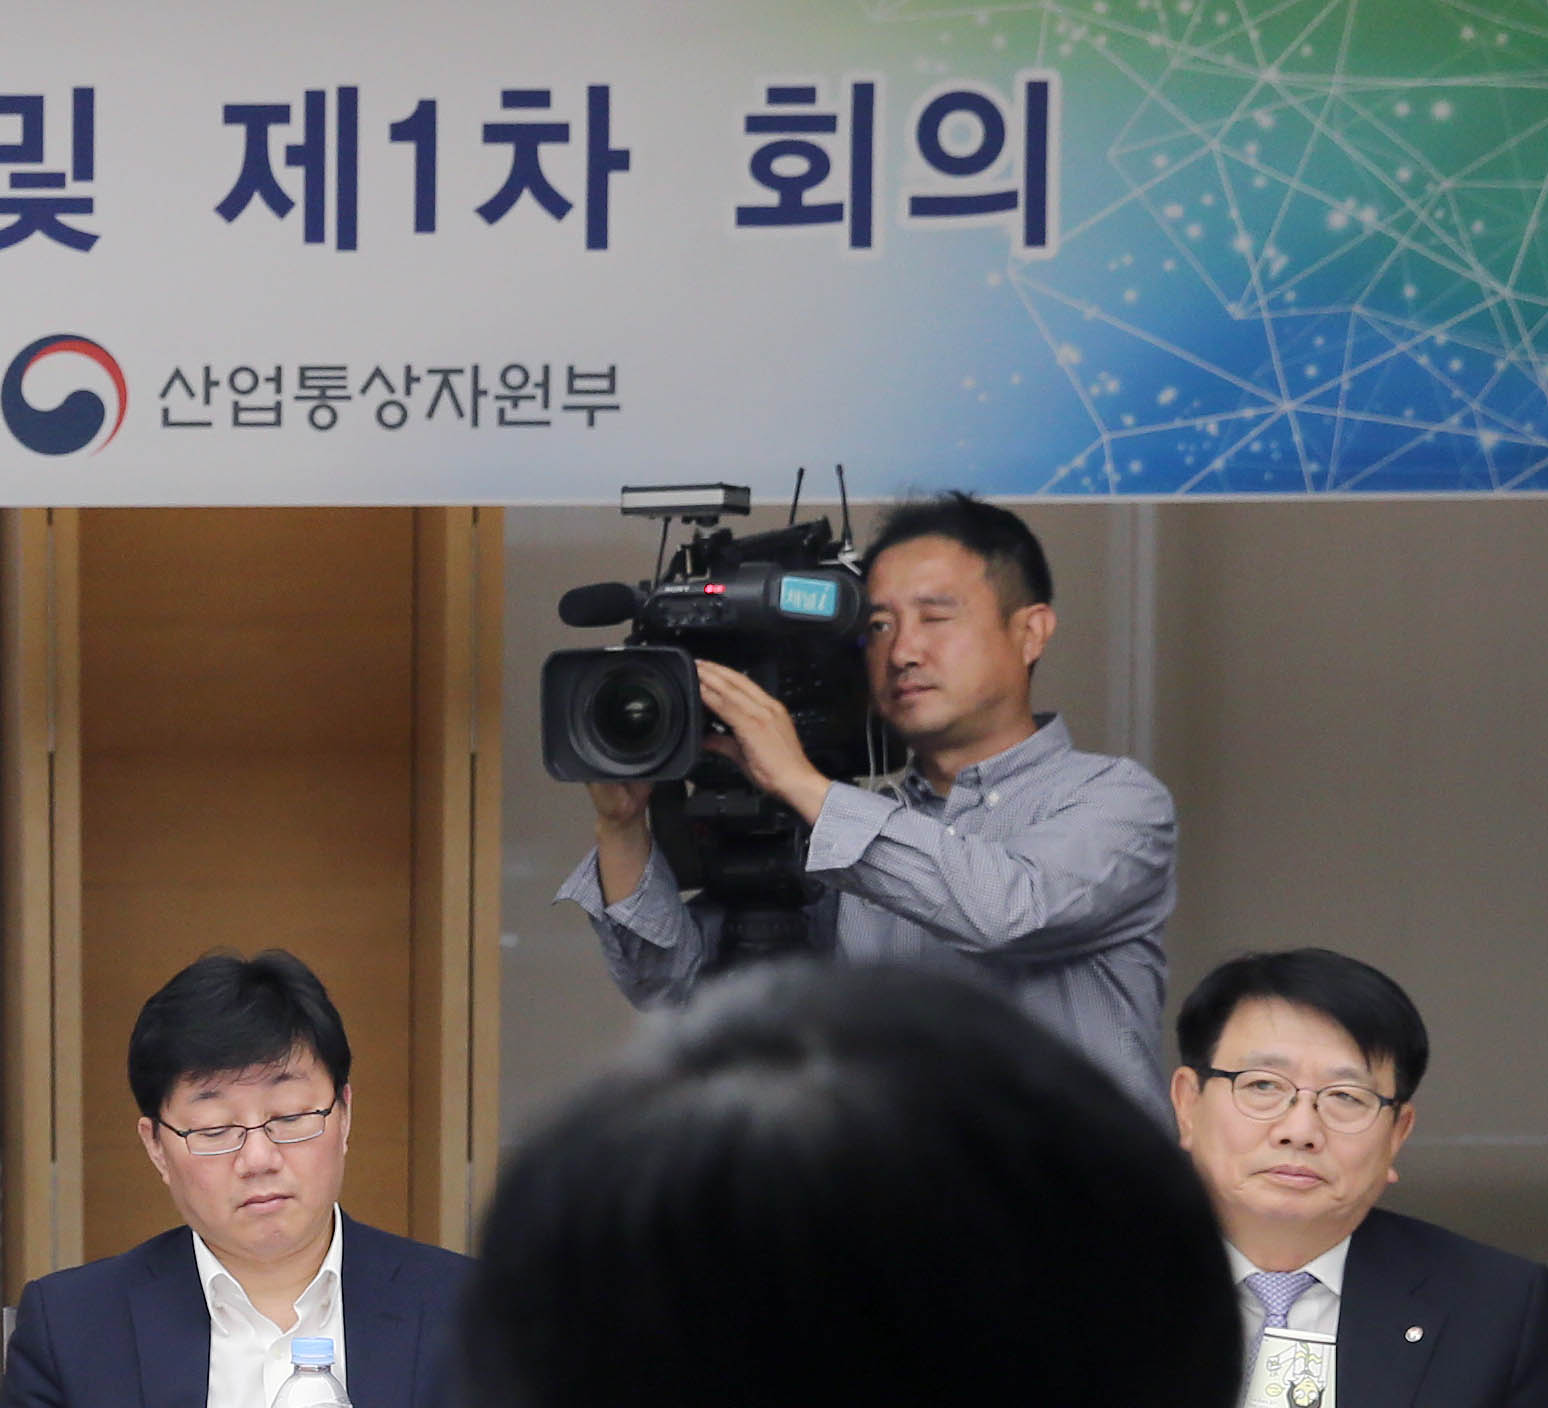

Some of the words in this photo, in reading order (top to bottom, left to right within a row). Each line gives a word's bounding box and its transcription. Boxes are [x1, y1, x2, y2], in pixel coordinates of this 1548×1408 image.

[215, 85, 632, 251] 제1차
[736, 80, 1049, 249] 회의
[158, 362, 622, 432] 산업통상자원부
